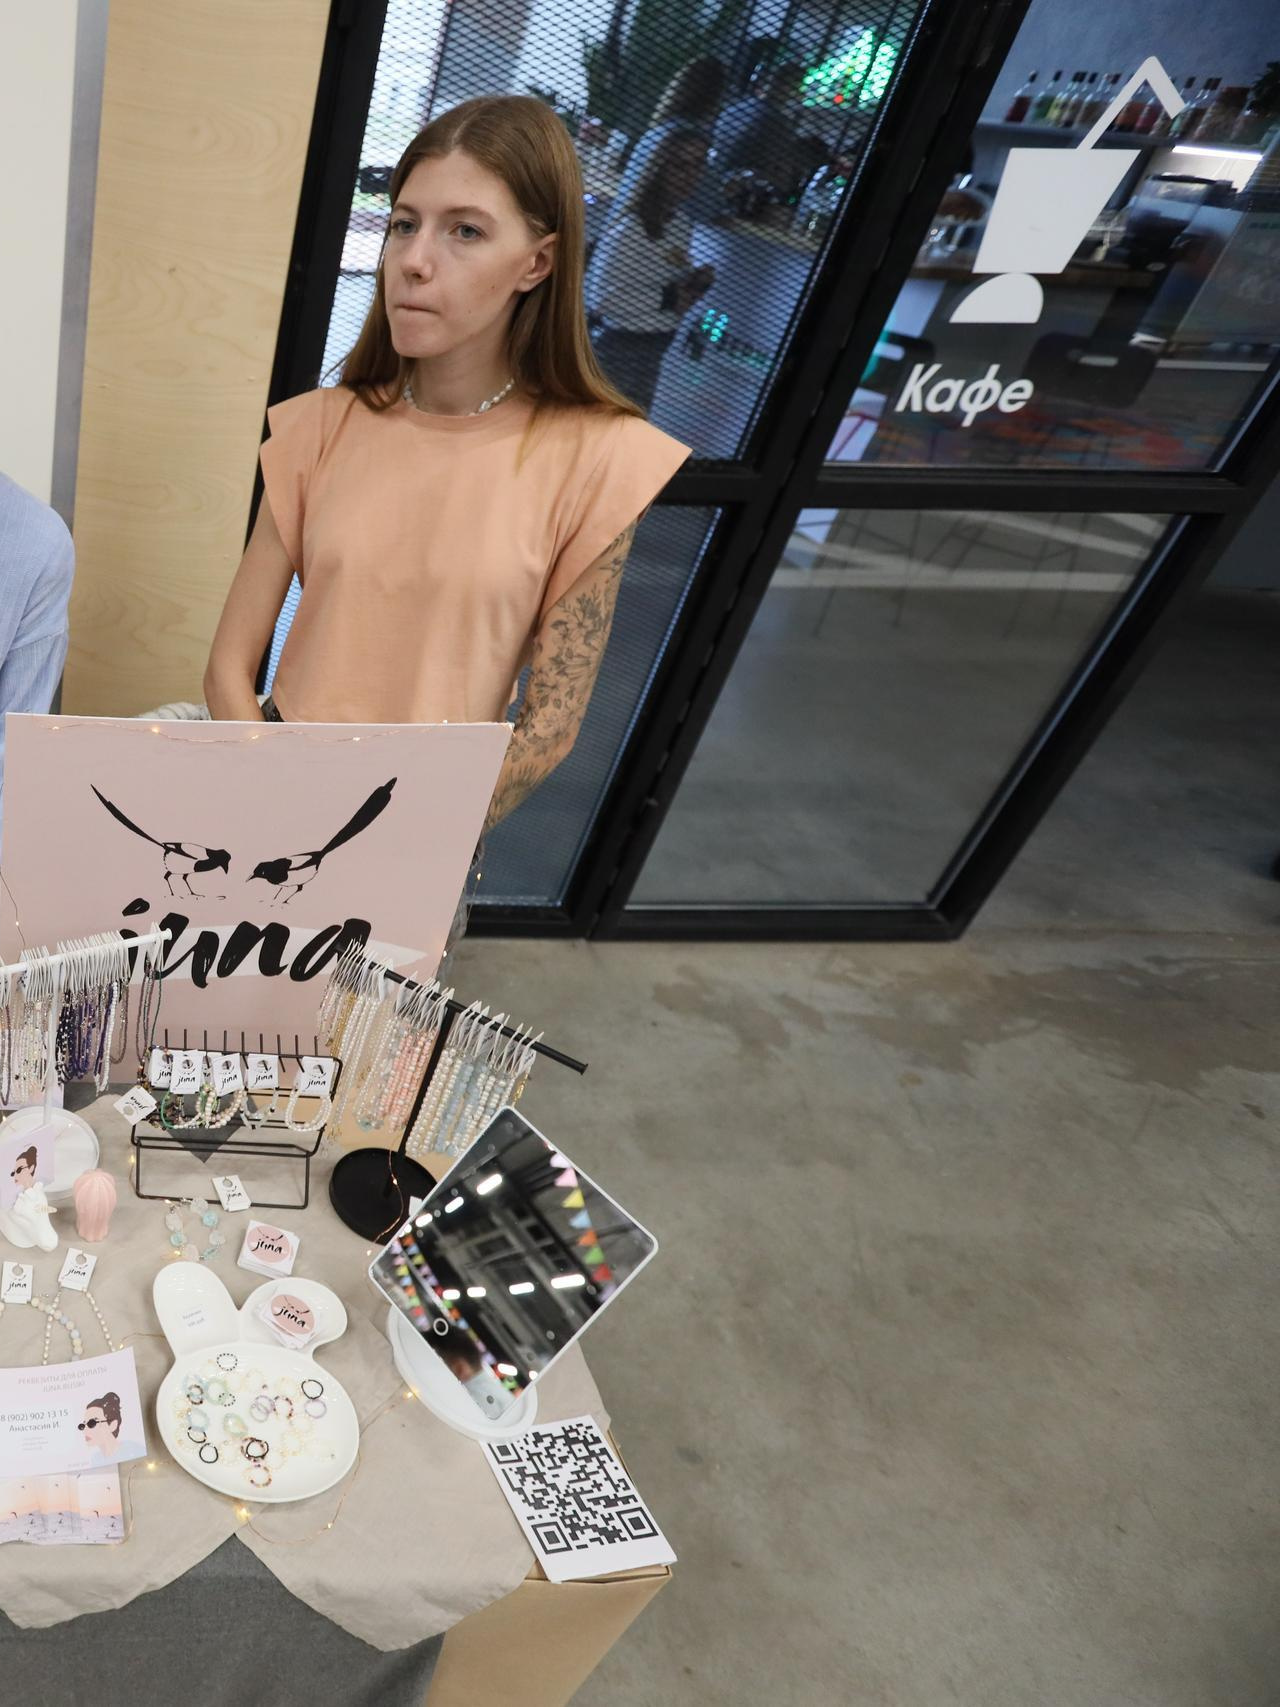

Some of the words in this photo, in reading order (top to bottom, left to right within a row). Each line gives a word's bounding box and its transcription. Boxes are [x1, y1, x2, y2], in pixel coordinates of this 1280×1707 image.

[894, 363, 1034, 428] Кафе
[156, 1070, 172, 1082] jun
[0, 1414, 6, 1422] 8
[7, 1412, 28, 1422] (902)
[29, 1411, 45, 1420] 902
[47, 1410, 57, 1418] 13
[59, 1408, 69, 1417] 15
[8, 1423, 51, 1432] Анастасия
